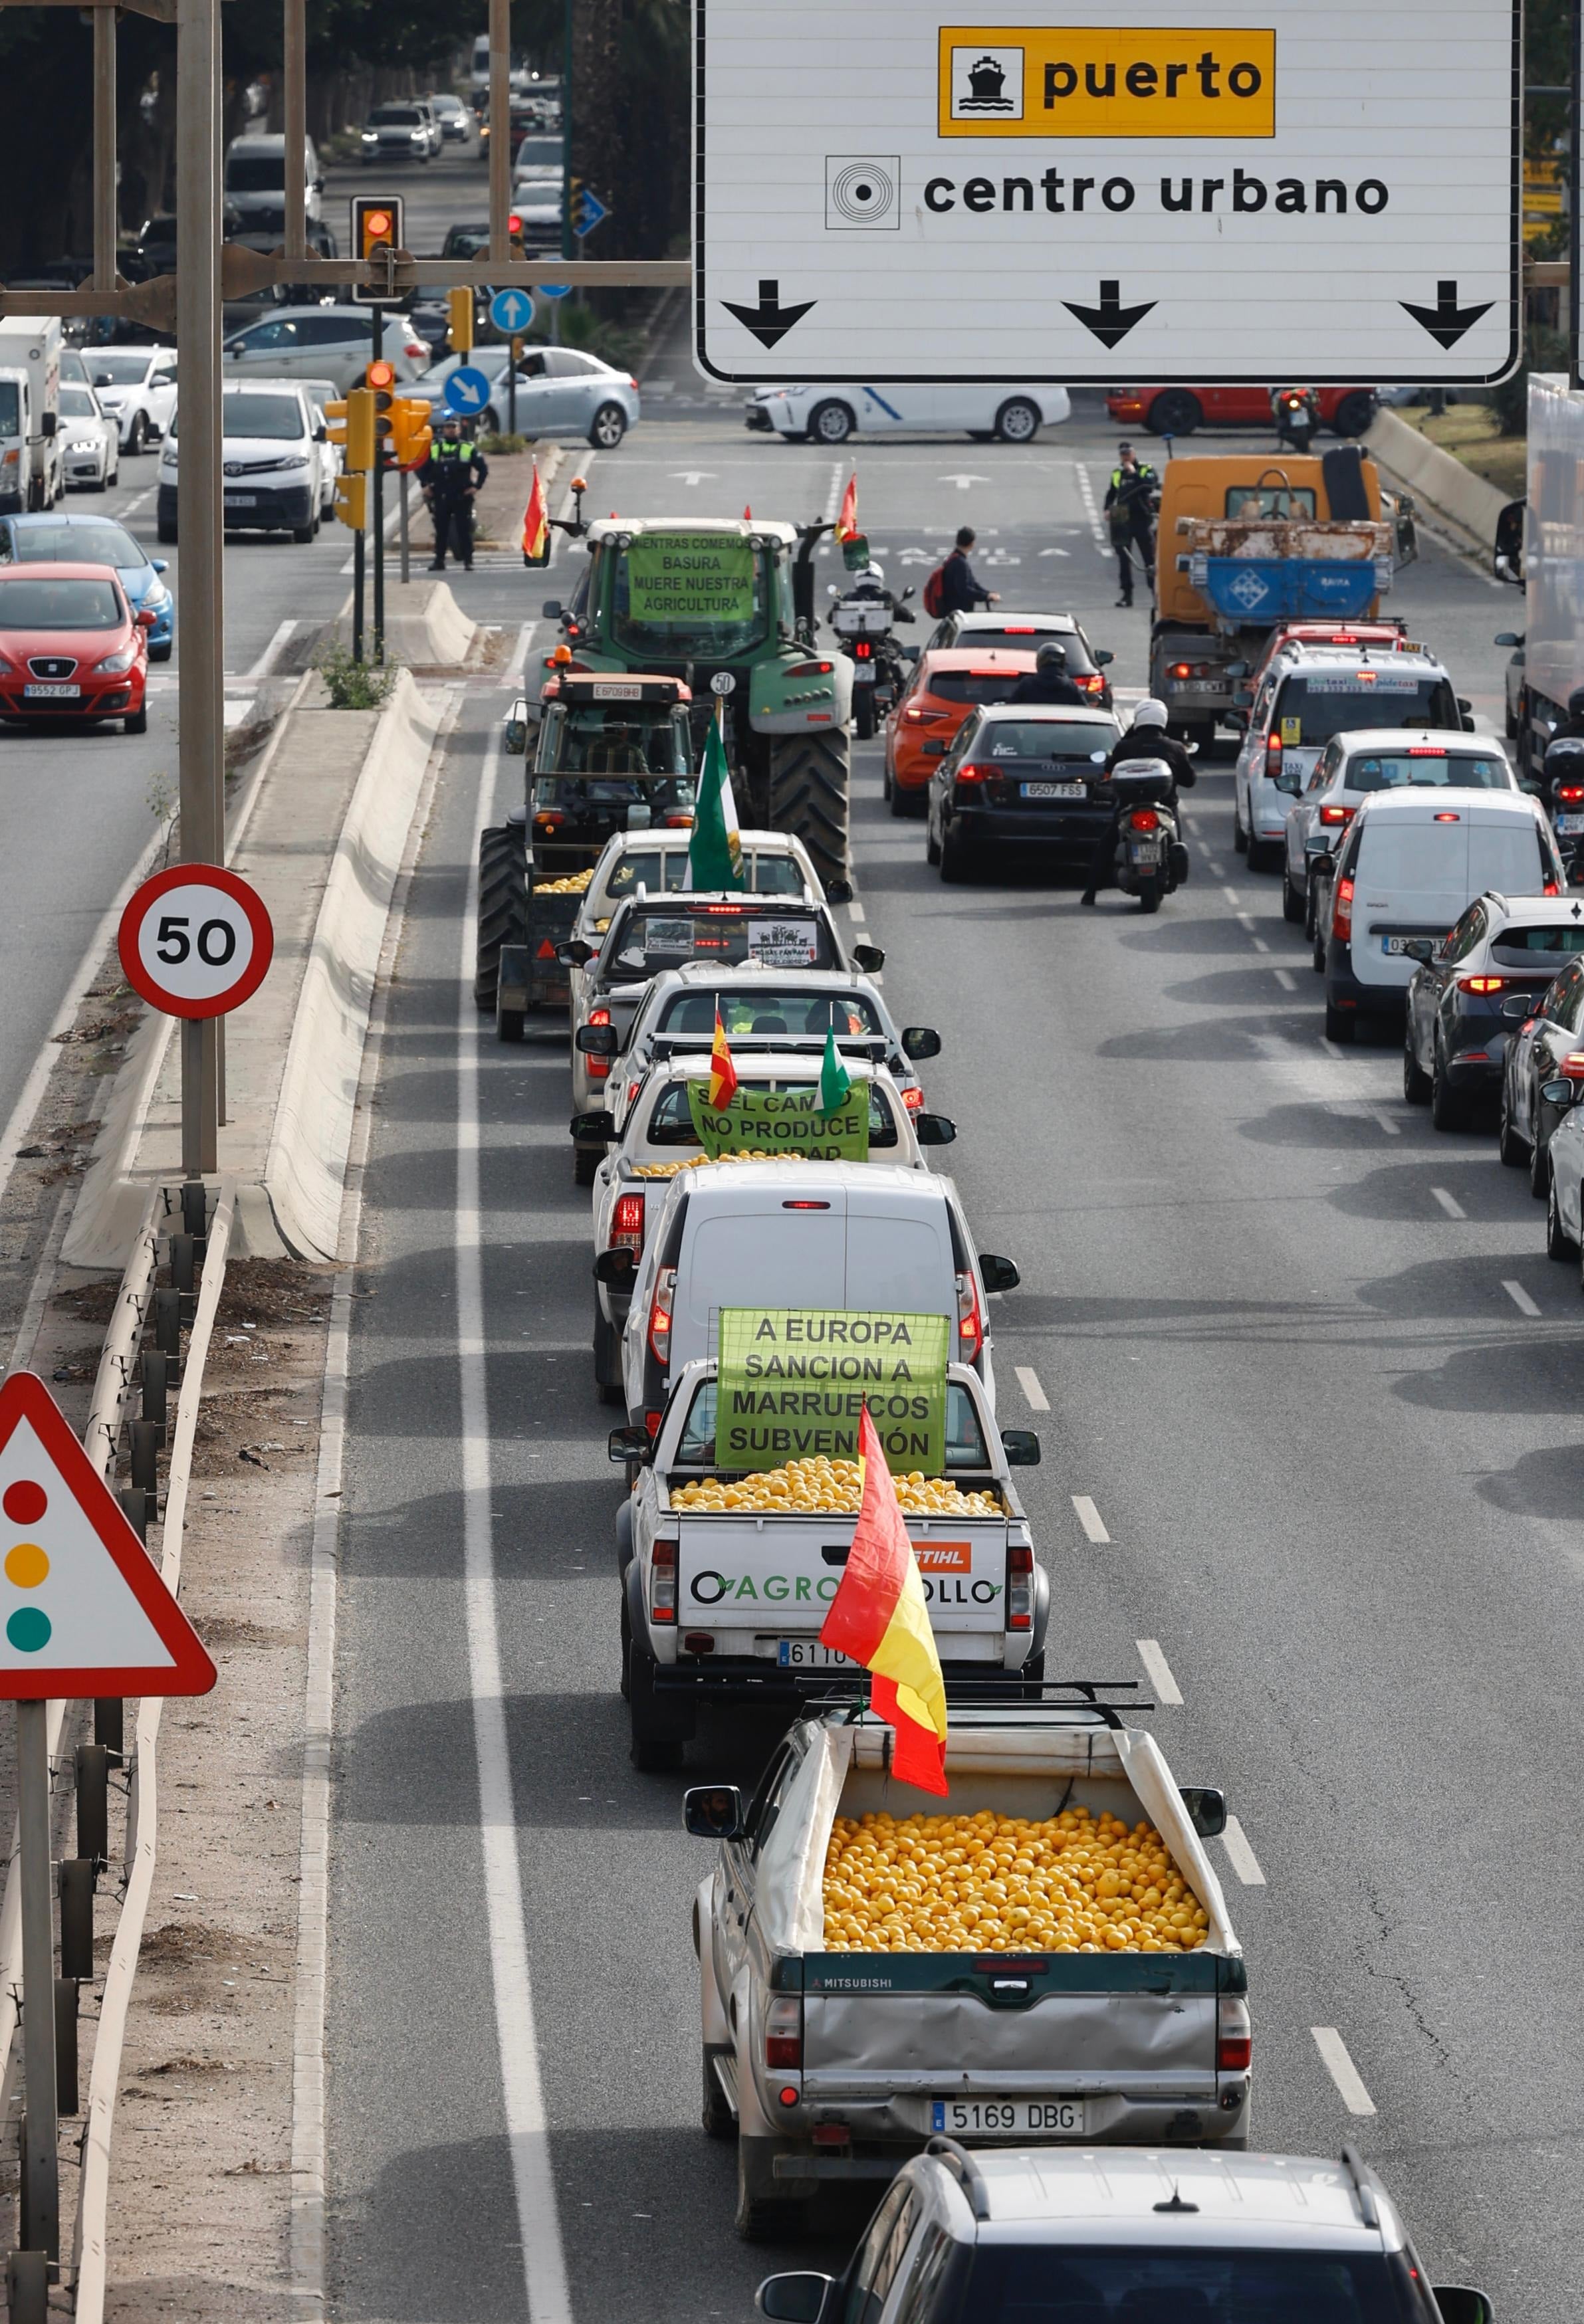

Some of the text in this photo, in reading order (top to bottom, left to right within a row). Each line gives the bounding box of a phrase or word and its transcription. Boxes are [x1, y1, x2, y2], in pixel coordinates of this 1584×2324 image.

[1044, 51, 1262, 109] puerto
[924, 167, 1389, 214] centro urbano
[631, 538, 689, 549] MIENTRAS
[663, 557, 721, 570] BASURA
[635, 577, 748, 590] MUERE NUESTRA
[644, 597, 739, 611] AGRICULTURA
[31, 685, 78, 695] 9552 GPJ
[716, 675, 730, 692] 50
[156, 916, 236, 966] 50
[764, 1090, 851, 1113] CAMO
[702, 1114, 860, 1138] NO PRODUCE
[755, 1318, 912, 1346] A EUROPA
[744, 1354, 913, 1382] SANCION A
[733, 1391, 929, 1420] MARRUECOS
[729, 1426, 929, 1456] SUBVENIÓN
[824, 1978, 891, 1988] MITSUBISHI
[953, 2105, 1014, 2129] 5169
[1028, 2105, 1074, 2129] DBG
